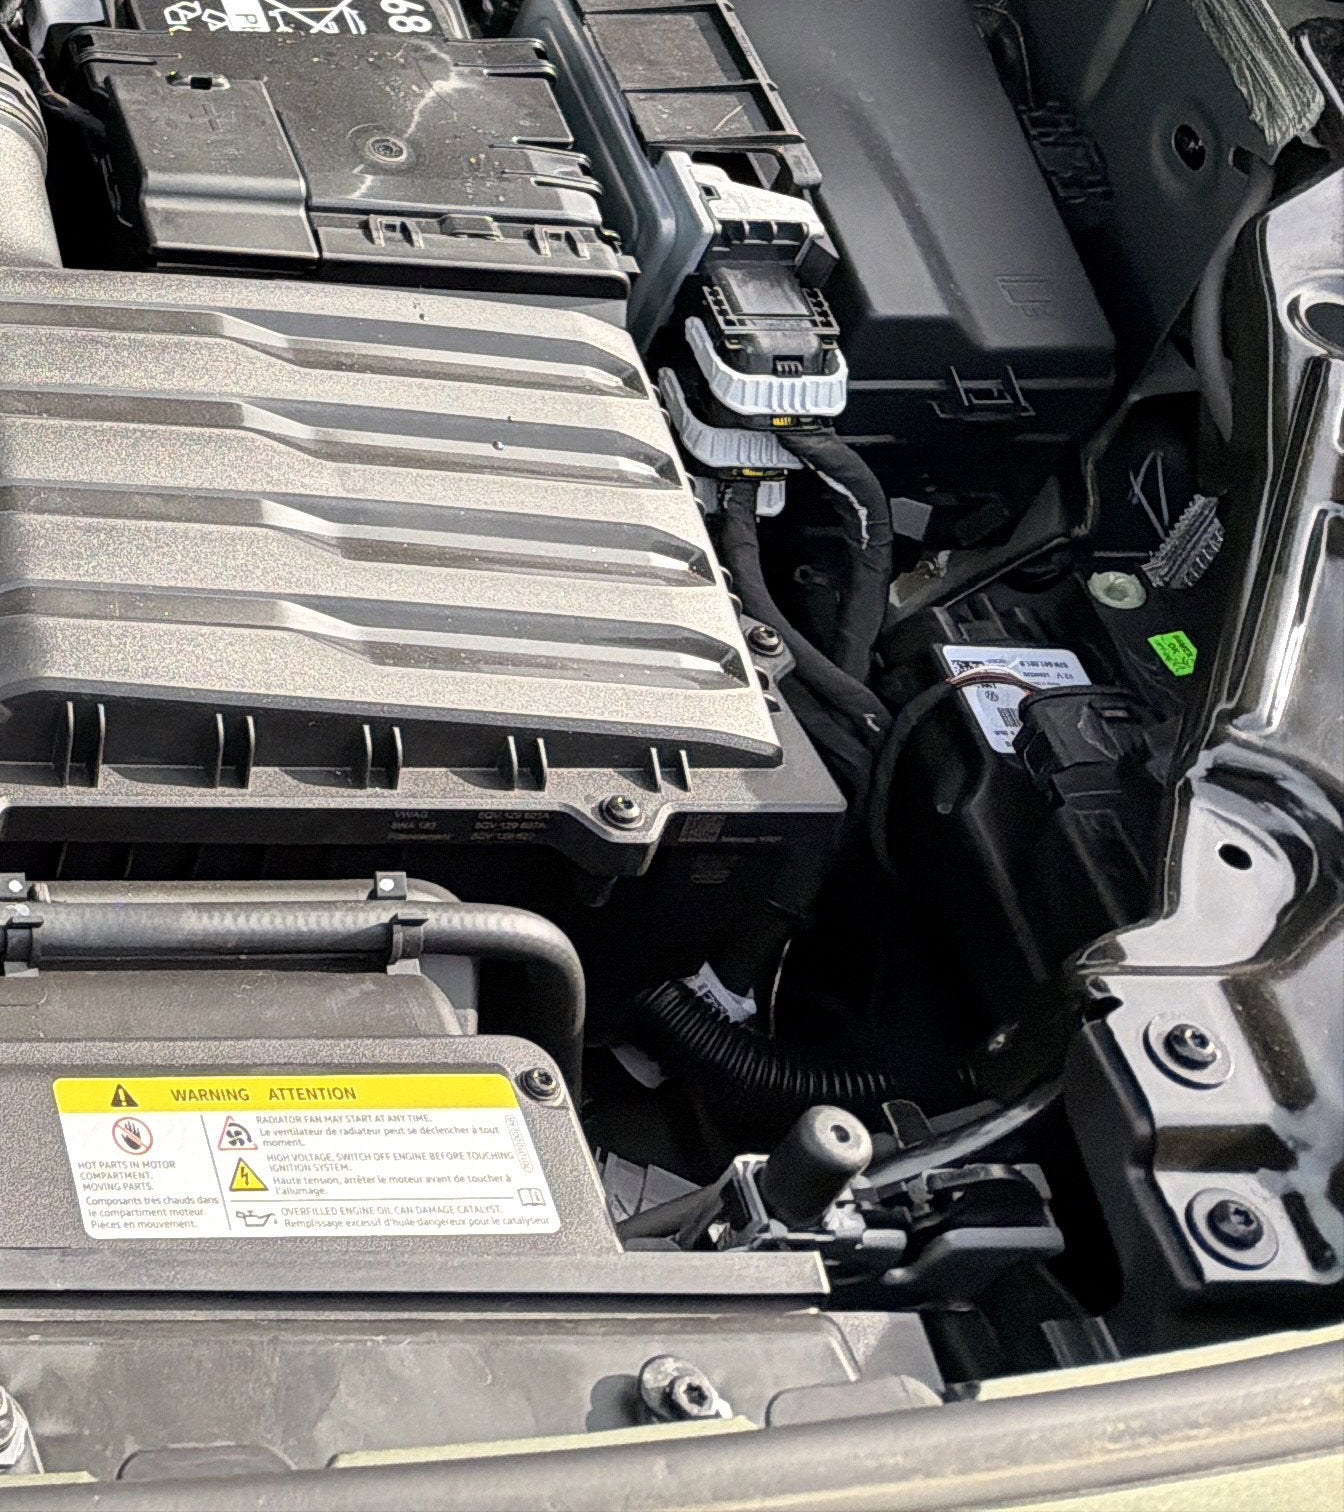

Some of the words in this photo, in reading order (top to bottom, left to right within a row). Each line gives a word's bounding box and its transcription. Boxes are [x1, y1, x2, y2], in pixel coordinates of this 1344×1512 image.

[170, 1088, 250, 1102] WARNING
[269, 1086, 357, 1101] ATTENTION
[256, 1115, 301, 1124] RADIATOR
[304, 1115, 322, 1123] FAN
[324, 1115, 343, 1123] MAY
[345, 1115, 372, 1123] START
[375, 1114, 385, 1122] AT
[388, 1114, 406, 1122] ANY
[407, 1114, 433, 1122] TIME.
[259, 1128, 271, 1136] Le
[273, 1127, 323, 1136] ventilateur
[326, 1127, 337, 1135] de
[339, 1126, 381, 1135] radiateur
[384, 1127, 404, 1136] peut
[267, 1153, 290, 1162] HIGH
[336, 1153, 372, 1161] SWITCH
[373, 1153, 391, 1161] OFF
[393, 1153, 427, 1161] ENGINE
[429, 1152, 465, 1160] BEFORE
[467, 1152, 514, 1160] TOUCHING
[78, 1161, 96, 1169] HOT
[99, 1161, 128, 1169] PARTS
[269, 1164, 312, 1172] IGNITION
[313, 1164, 352, 1172] SYSTEM.
[273, 1177, 302, 1185] Haute
[377, 1176, 387, 1184] le
[388, 1176, 423, 1184] moteur
[454, 1175, 465, 1183] de
[467, 1175, 503, 1183] toucher
[83, 1183, 121, 1191] MOVING
[86, 1196, 142, 1207] Composants
[163, 1196, 195, 1205] chauds
[197, 1196, 219, 1205] dans
[88, 1209, 97, 1217] le
[100, 1208, 166, 1218] compartiment
[281, 1207, 338, 1215] OVERFILLED
[340, 1207, 375, 1215] ENGINE
[416, 1206, 455, 1214] DAMAGE
[284, 1219, 343, 1229] Remplissage
[345, 1218, 382, 1227] excessif
[469, 1218, 490, 1227] pour
[491, 1217, 501, 1225] le
